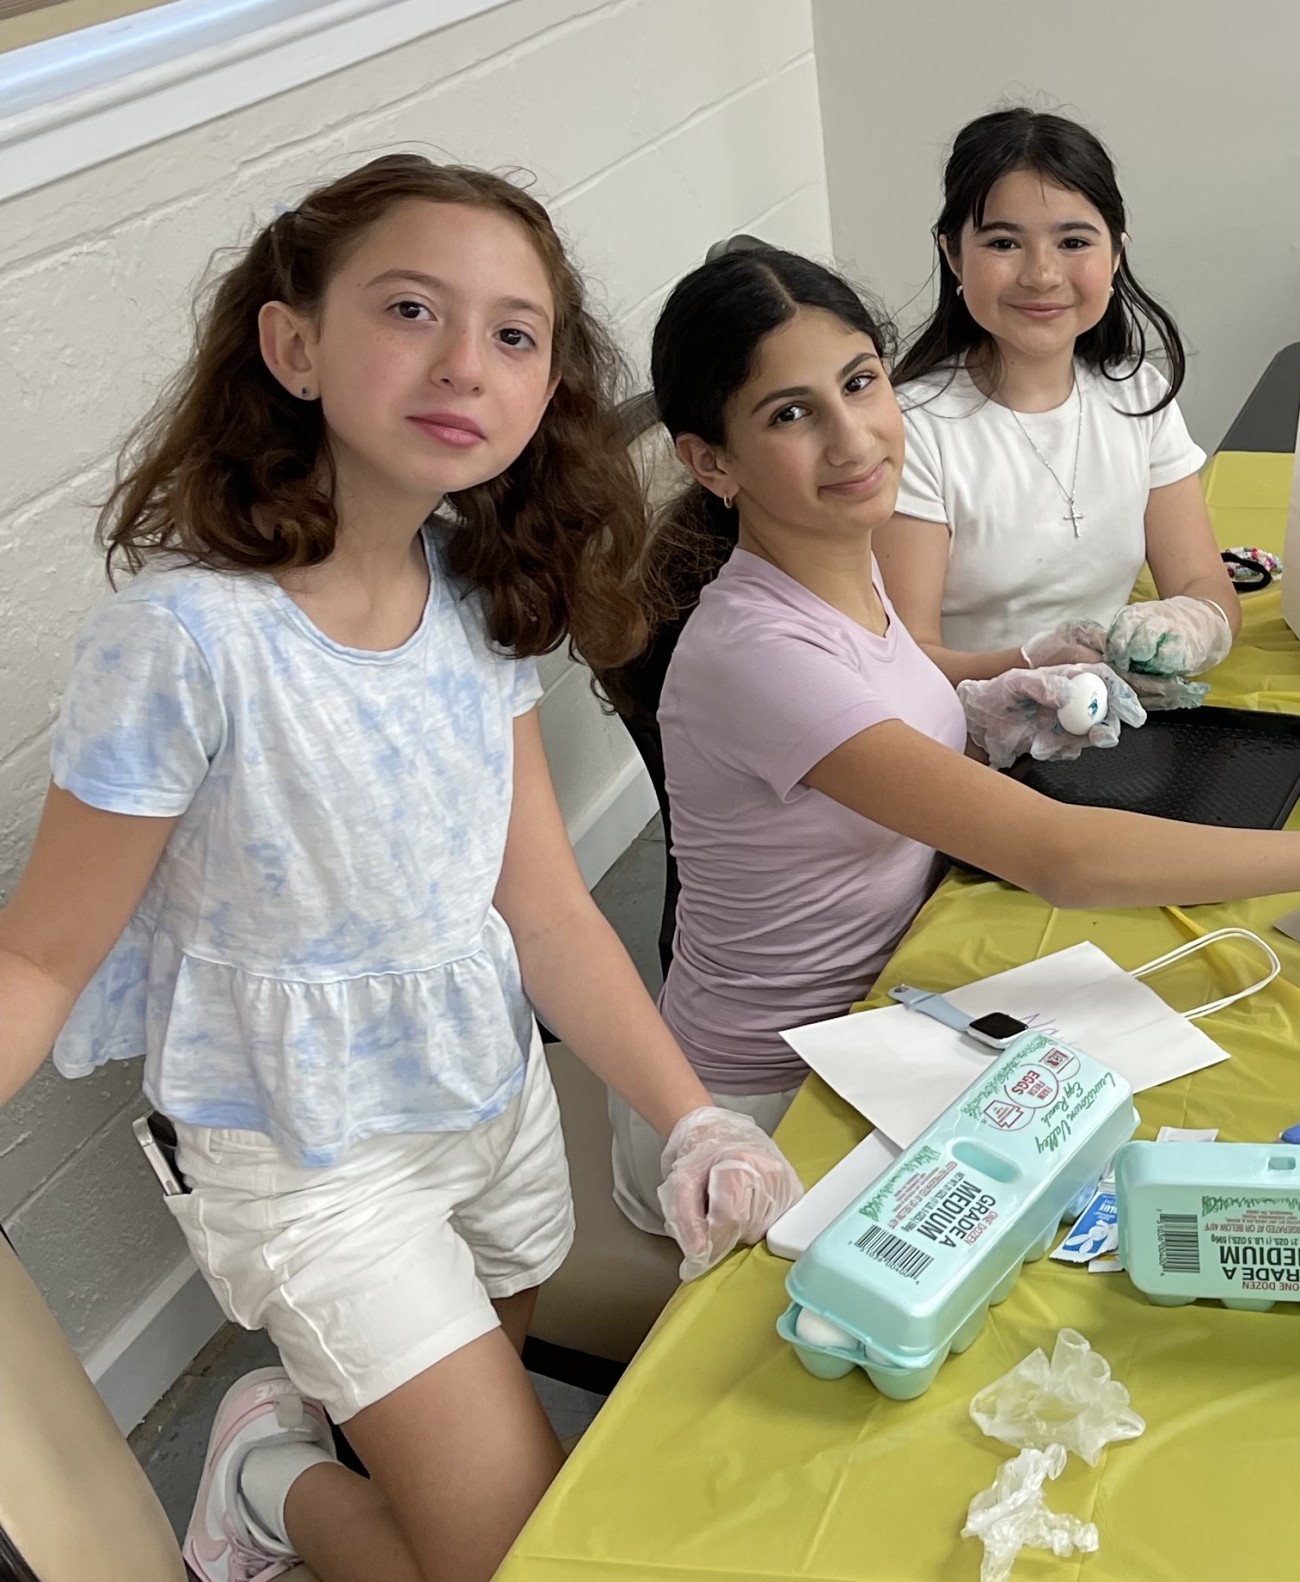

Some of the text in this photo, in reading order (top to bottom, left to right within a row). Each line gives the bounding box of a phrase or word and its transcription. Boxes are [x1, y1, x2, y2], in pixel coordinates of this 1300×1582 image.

[1011, 1069, 1040, 1095] EGGS
[1027, 1080, 1045, 1097] FRESH
[1035, 1072, 1114, 1153] Lewistown Valley
[1041, 1081, 1082, 1126] Egg Ranch
[916, 1180, 981, 1240] MEDIUM
[938, 1195, 995, 1247] GRADE A
[963, 1210, 998, 1245] ONE DOZEN
[1220, 1223, 1243, 1231] BELOW
[1245, 1224, 1255, 1232] OR
[1256, 1224, 1264, 1232] AT
[1221, 1266, 1236, 1279] A
[1242, 1281, 1299, 1291] ONE DOZEN
